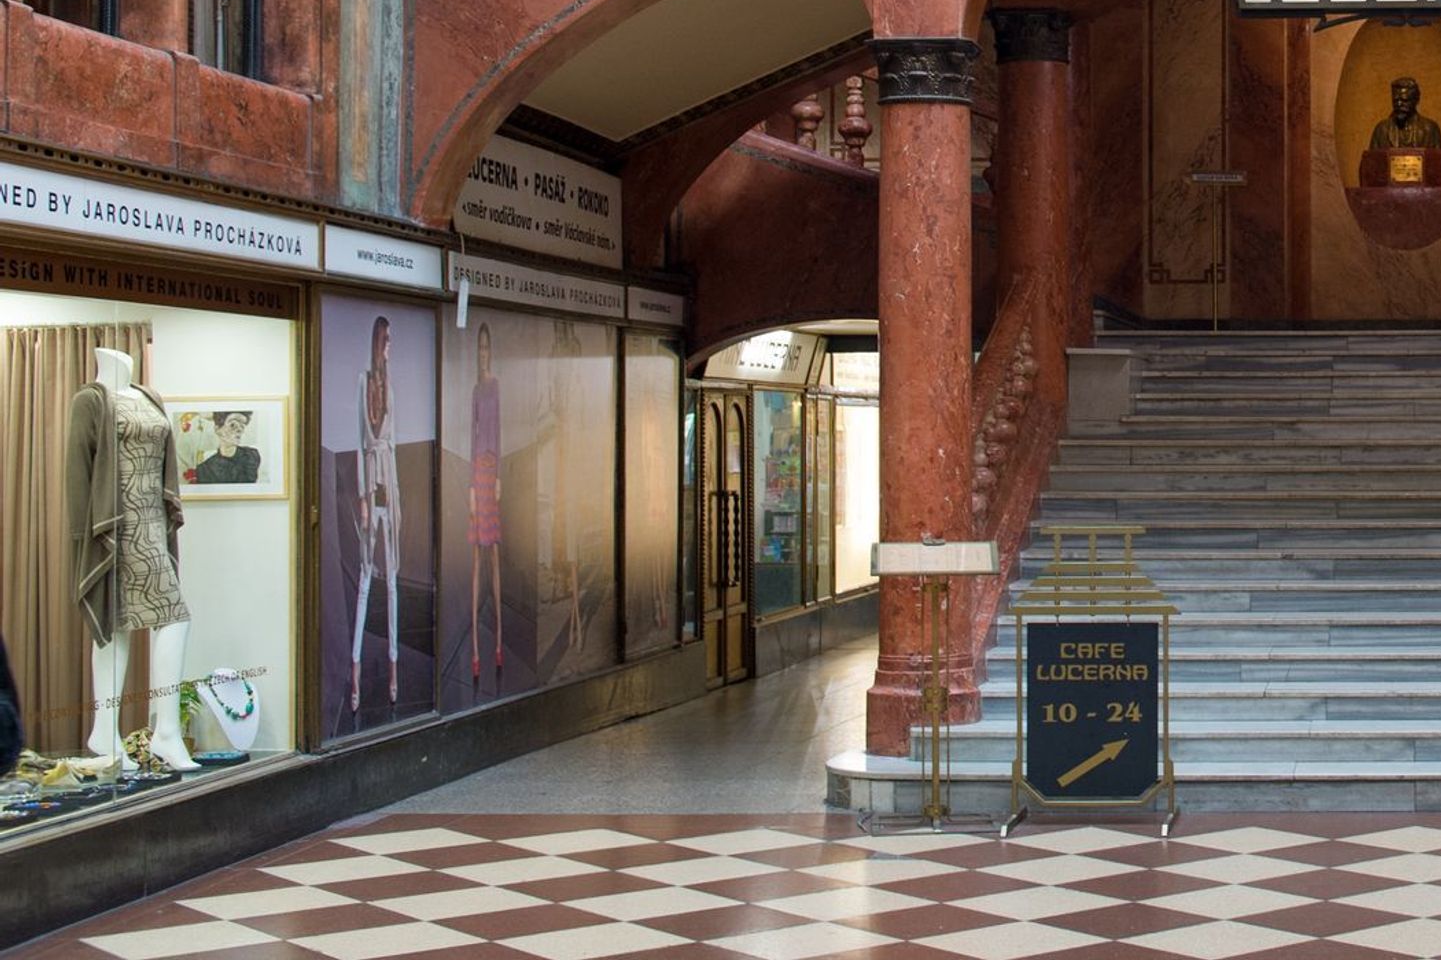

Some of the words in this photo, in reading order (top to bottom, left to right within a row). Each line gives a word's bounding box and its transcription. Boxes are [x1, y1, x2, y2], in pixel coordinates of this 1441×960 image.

[534, 173, 566, 203] PASÁŽ
[578, 187, 609, 218] ROKOKO
[48, 192, 72, 214] BY
[82, 198, 185, 235] JAROSLAVA
[194, 219, 302, 256] PROCHÁZKOVÁ
[357, 248, 414, 270] www.jaroslava.cz
[64, 263, 109, 287] WITH
[117, 271, 241, 305] INTERNATIONAL
[248, 291, 283, 310] SOUL
[519, 280, 566, 300] JAROSLAVA
[1060, 642, 1125, 659] CAFE
[1036, 664, 1148, 681] LUCERNA
[1042, 703, 1077, 723] 10
[1106, 701, 1143, 723] 24
